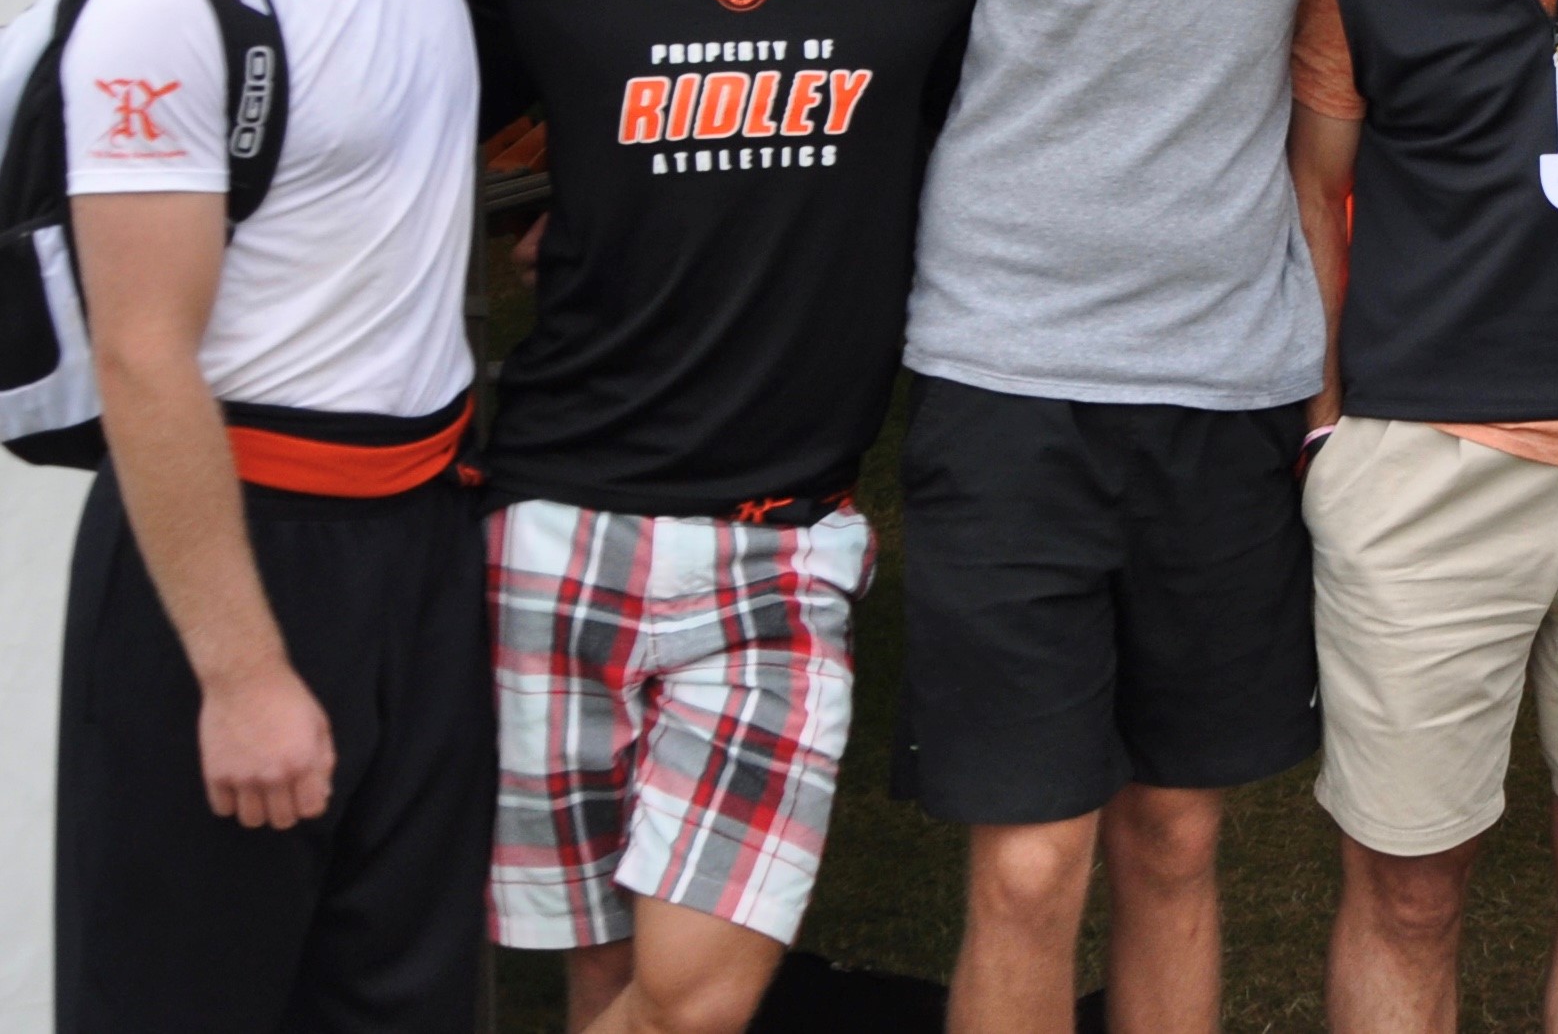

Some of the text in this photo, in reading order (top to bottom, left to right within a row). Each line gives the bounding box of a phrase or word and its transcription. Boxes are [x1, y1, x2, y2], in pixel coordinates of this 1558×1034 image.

[651, 39, 834, 64] PROPERTY OF
[229, 45, 275, 158] OGIO
[618, 69, 873, 145] RIDLEY
[652, 144, 837, 175] ATHLETICS
